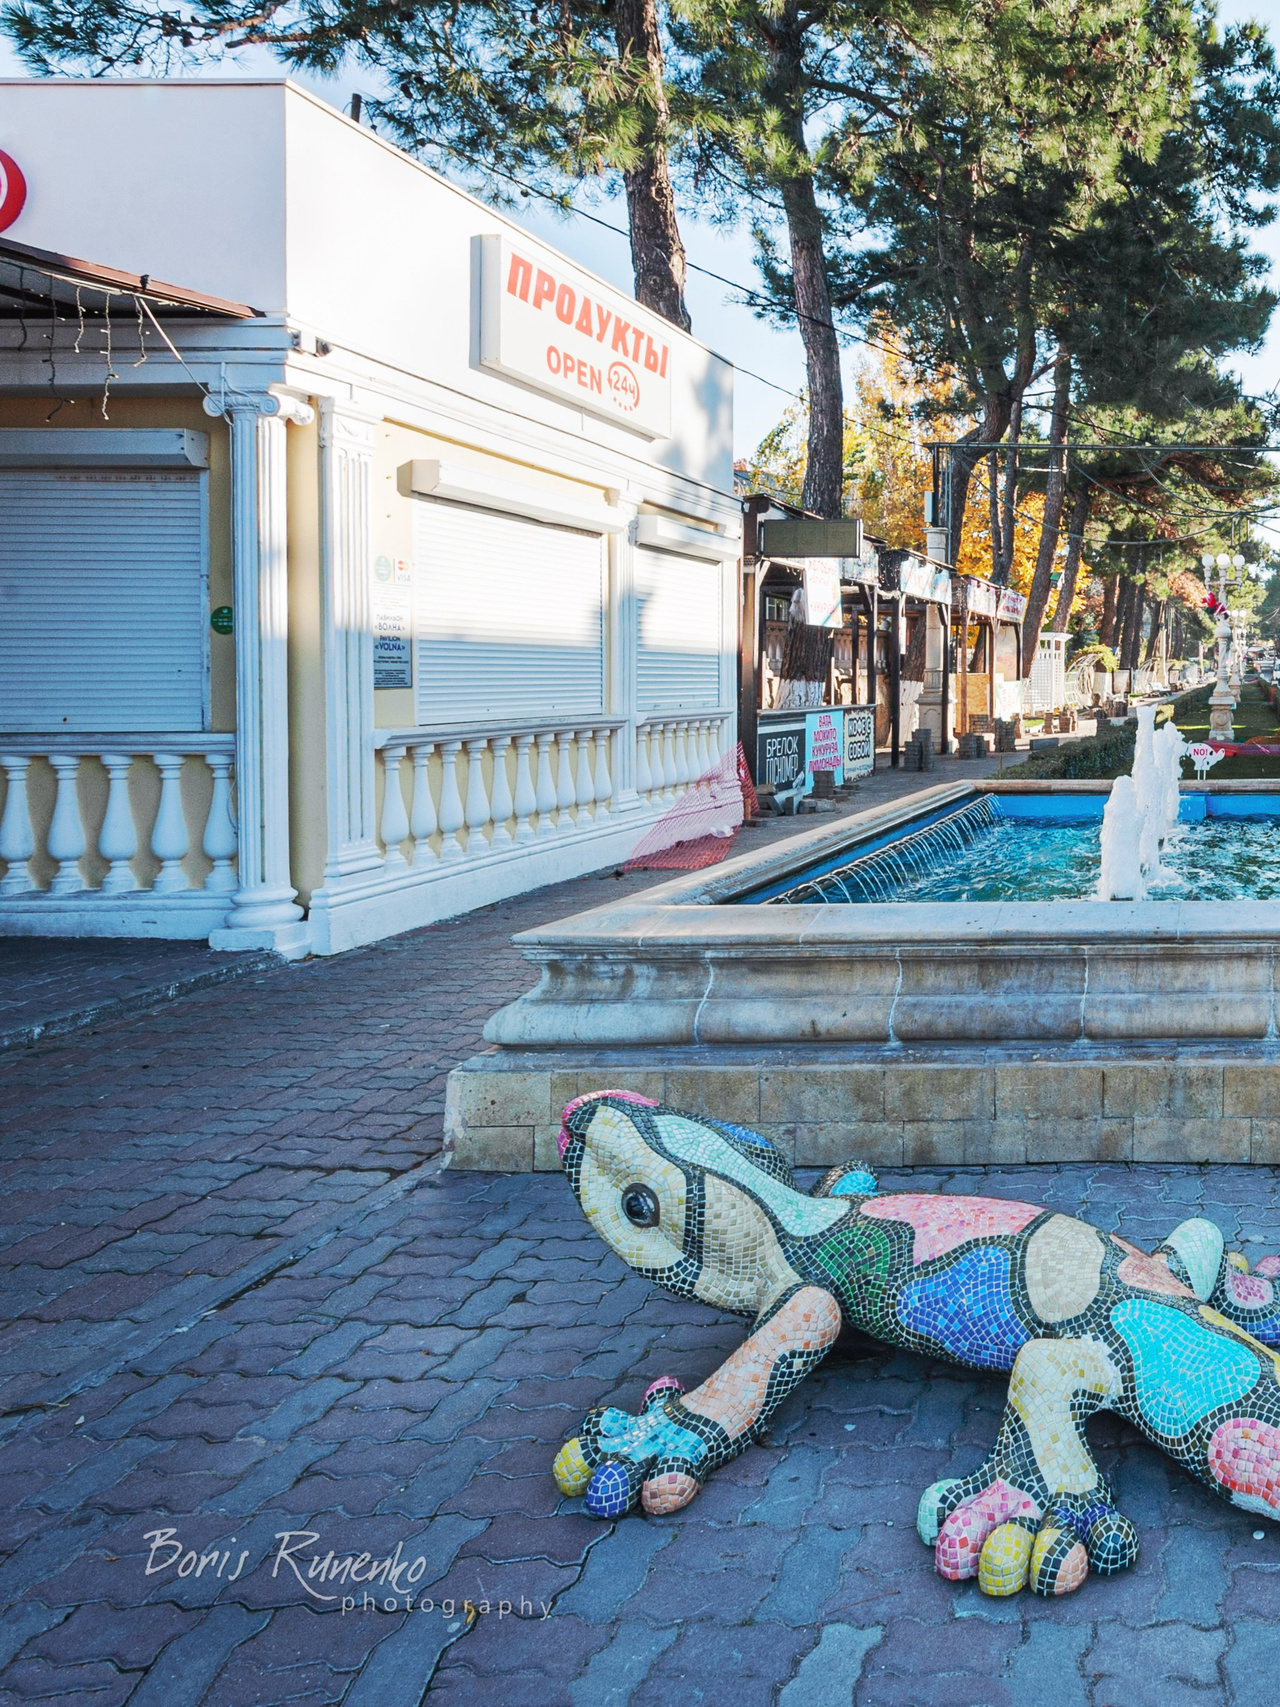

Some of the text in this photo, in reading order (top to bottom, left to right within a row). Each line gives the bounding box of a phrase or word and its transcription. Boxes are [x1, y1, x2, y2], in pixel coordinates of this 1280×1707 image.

[507, 252, 669, 379] ПРОДУКТЫ
[546, 345, 603, 395] OPEN
[818, 714, 832, 728] ВАТА
[848, 717, 866, 738] КОФЕ
[766, 736, 799, 758] БРЕЛОК
[811, 741, 839, 758] КУКУРУЗА
[848, 735, 871, 762] СОБОЙ
[1193, 748, 1208, 756] NO!
[808, 755, 842, 774] ЛИМОНАДЫ
